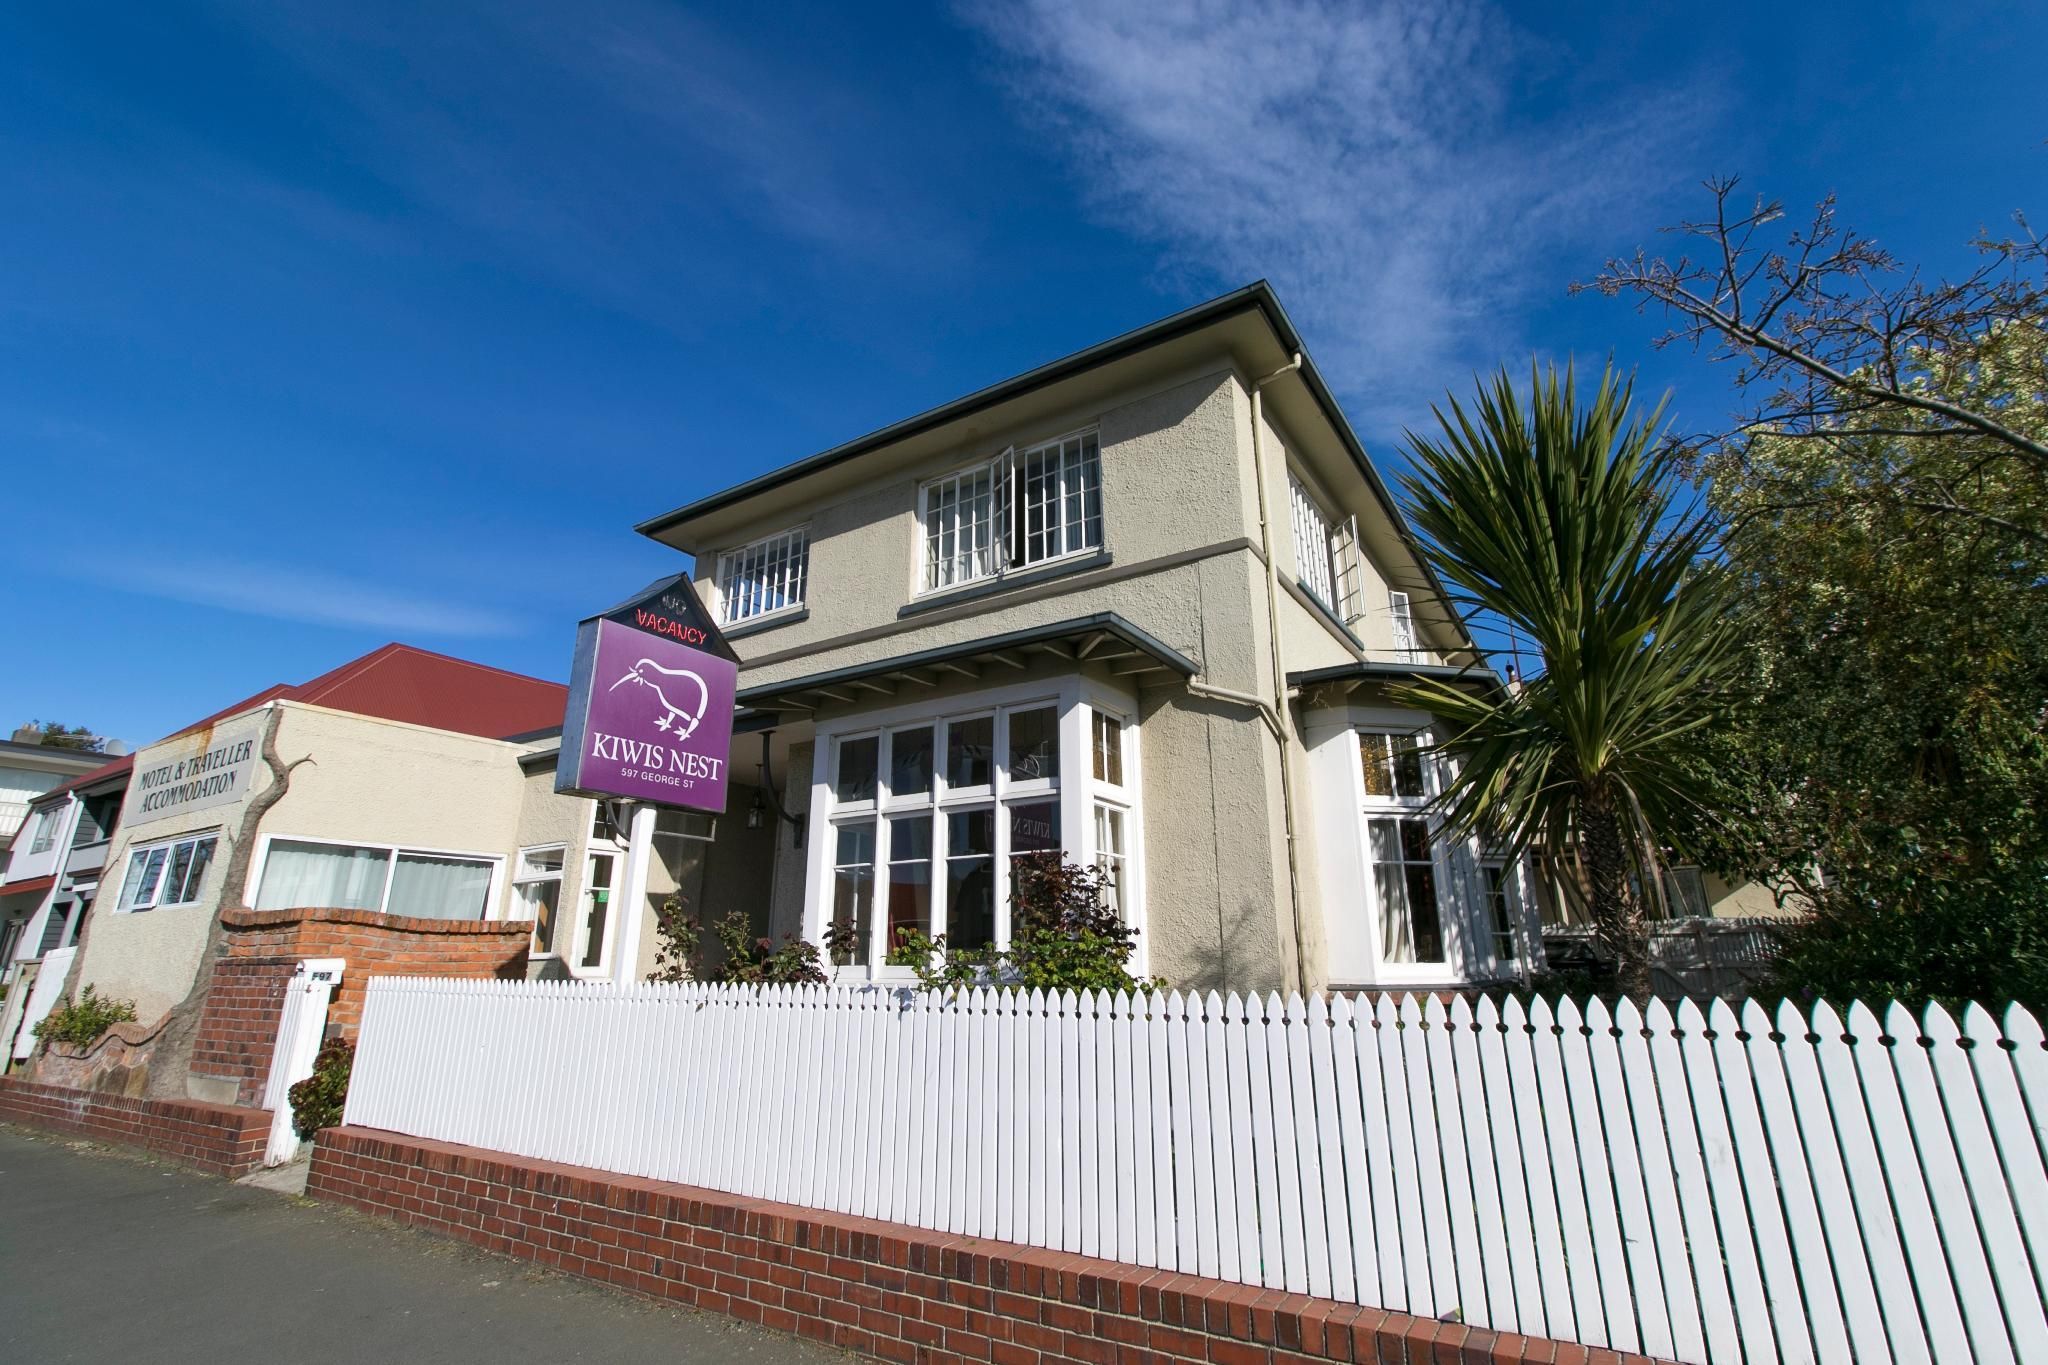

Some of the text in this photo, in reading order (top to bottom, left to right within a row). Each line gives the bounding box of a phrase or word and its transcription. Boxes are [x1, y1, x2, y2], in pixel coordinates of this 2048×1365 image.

[637, 608, 706, 644] VACANCY
[138, 740, 253, 791] MOTEL & TRAVELLER
[592, 732, 722, 780] KIWIS NEST
[140, 770, 238, 814] ACCOMMODATION
[621, 768, 694, 789] 597 GEORGE ST
